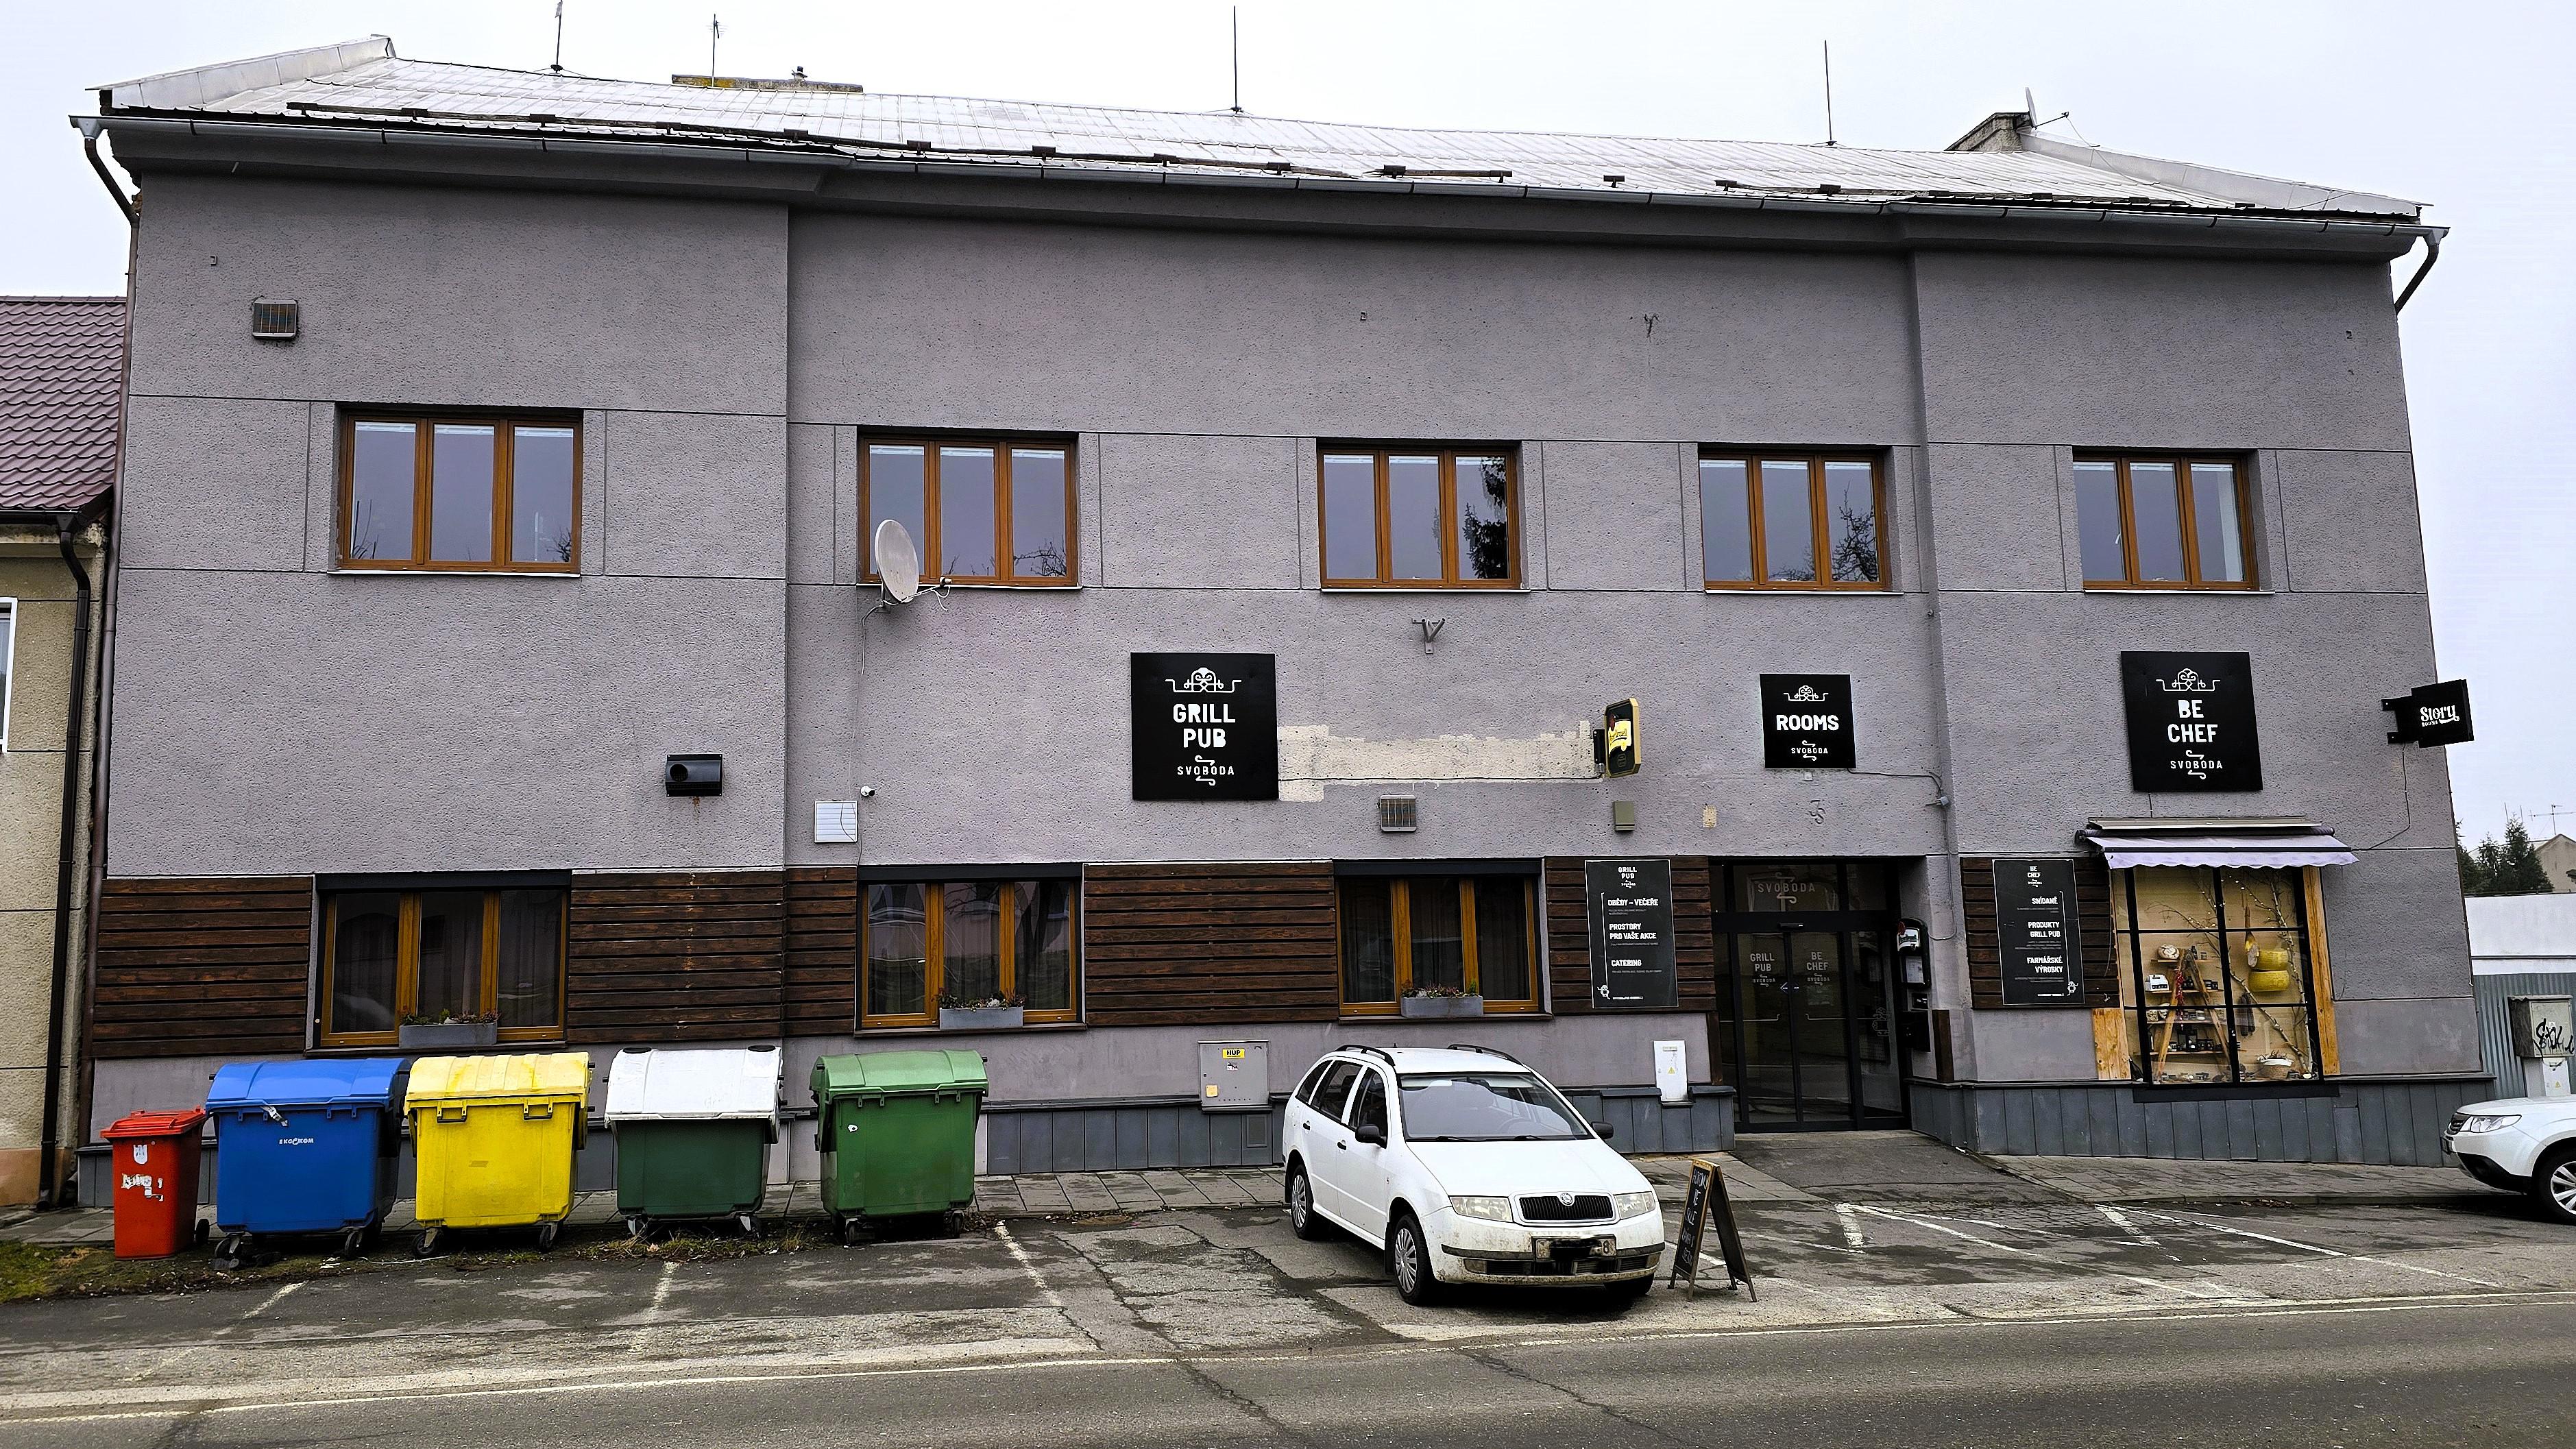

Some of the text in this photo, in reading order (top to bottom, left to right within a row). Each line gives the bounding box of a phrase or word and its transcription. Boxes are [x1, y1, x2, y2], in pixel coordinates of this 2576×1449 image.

[1173, 703, 1236, 723] GRILL
[2178, 699, 2204, 718] BE
[2420, 705, 2460, 724] Story
[1776, 714, 1840, 731] ROOMS
[2167, 723, 2218, 743] CHEF
[1183, 728, 1226, 748] PUB
[1790, 746, 1829, 755] SVOBODA
[2170, 760, 2223, 769] SVOBODA
[1177, 766, 1235, 775] SVOBODA
[1758, 883, 1816, 893] SVOBODA
[1607, 897, 1659, 906] OBĚDY VEČEŘE
[2031, 896, 2058, 905] SNÍDANĚ
[1609, 923, 1642, 931] PROSTORY
[1623, 931, 1640, 940] VAŠE
[1749, 953, 1775, 962] GRILL
[1811, 951, 1823, 960] BE
[2026, 955, 2063, 964] FARMÁŘSKÉ
[1754, 963, 1772, 972] PUB
[1806, 962, 1829, 971] CHEF
[2034, 965, 2063, 973] VÝROBKY
